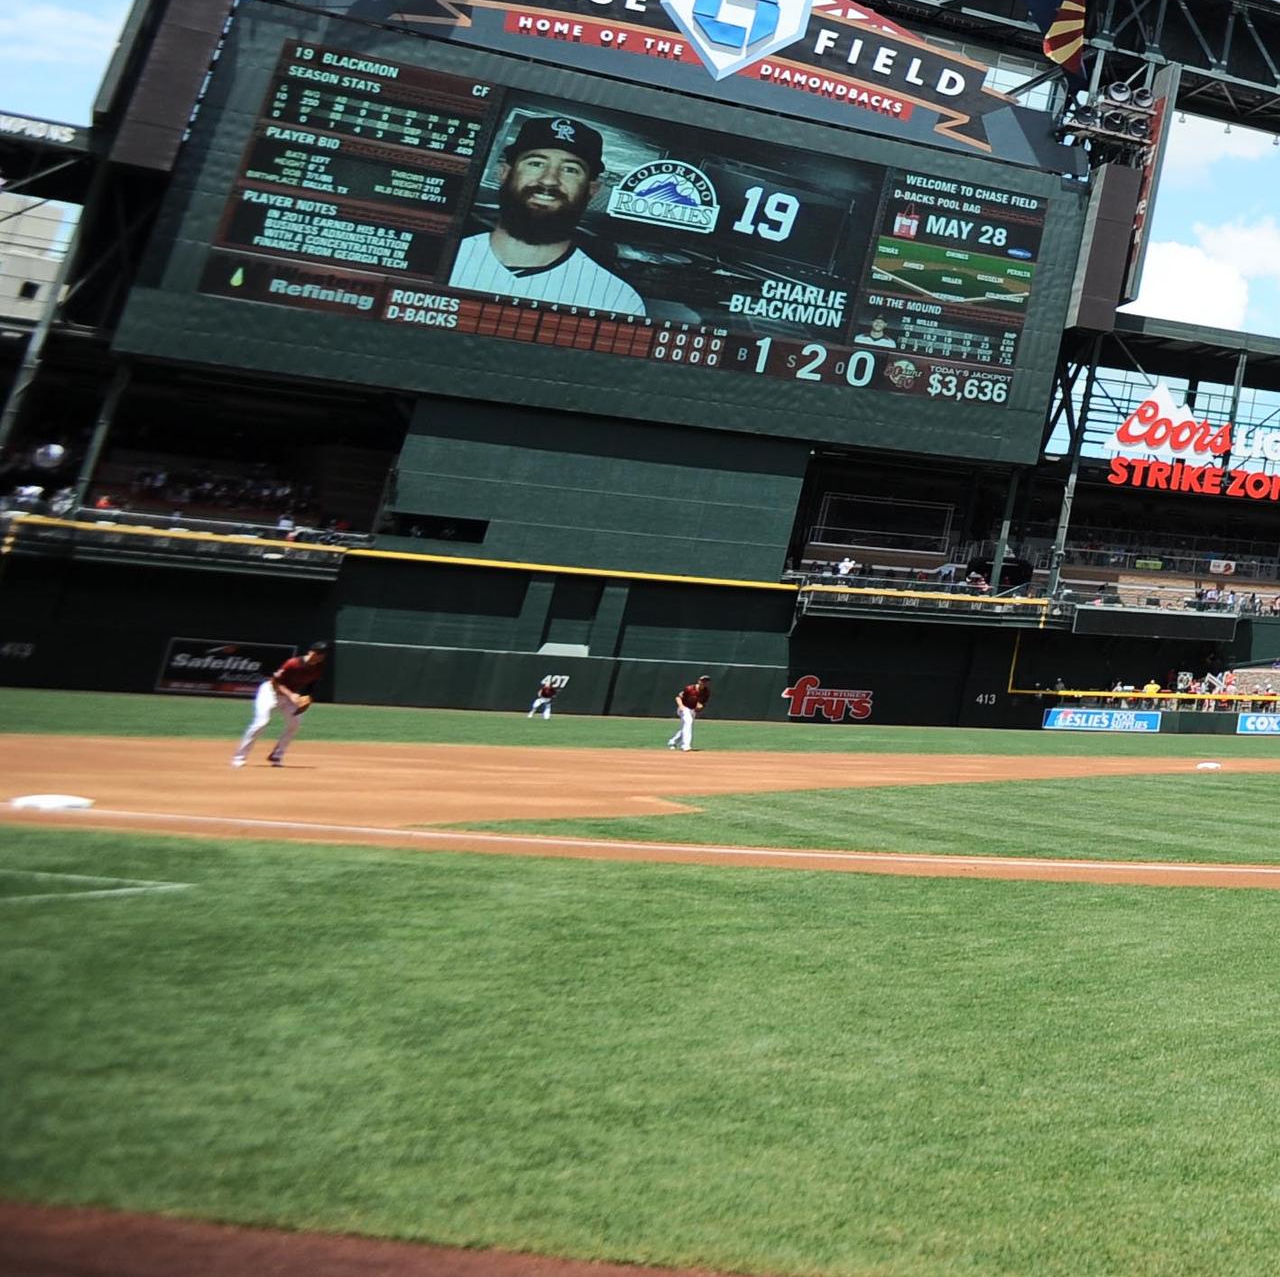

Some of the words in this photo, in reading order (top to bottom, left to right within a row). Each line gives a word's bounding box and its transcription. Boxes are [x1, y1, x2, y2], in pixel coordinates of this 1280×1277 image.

[296, 47, 314, 60] 19
[323, 53, 398, 78] BLACKMON
[472, 85, 490, 97] CF
[518, 16, 583, 36] HOME
[600, 30, 628, 44] OF
[644, 38, 684, 56] THE
[760, 64, 903, 113] DIAMONDBACKS
[814, 28, 966, 96] FIELD
[288, 66, 338, 85] SEASON
[342, 78, 380, 94] STATS
[266, 126, 315, 145] PLAYER
[318, 137, 340, 149] BIO
[426, 176, 445, 186] LEFT
[626, 163, 712, 202] COLORADO
[906, 175, 957, 194] WELCOME
[961, 187, 973, 197] TO
[975, 189, 1009, 204] CHASE
[1010, 196, 1038, 210] FIELD
[243, 190, 293, 208] PLAYER
[296, 200, 338, 215] NOTES
[615, 191, 713, 226] ROCKIES
[733, 186, 800, 242] 19
[894, 190, 934, 205] D-BACKS
[938, 197, 960, 210] POOL
[962, 204, 982, 214] BAG
[264, 219, 318, 236] BUSINESS
[320, 228, 409, 250] ADMINISTRATION
[267, 209, 280, 219] IN
[281, 212, 309, 224] 2011
[313, 216, 354, 231] EARNED
[357, 225, 374, 235] HIS
[401, 232, 412, 242] IN
[925, 215, 974, 240] MAY
[978, 225, 1007, 247] 28
[254, 236, 299, 252] FINANCE
[301, 244, 332, 257] FROM
[334, 249, 378, 265] GEORGIA
[379, 257, 408, 270] TECH
[264, 229, 292, 242] WITH
[295, 234, 302, 242] A
[305, 235, 390, 256] CONCENTRATION
[393, 249, 405, 259] IN
[269, 278, 375, 309] Refining
[391, 290, 461, 312] ROCKIES
[762, 280, 847, 310] CHARLIE
[869, 295, 883, 306] ON
[887, 298, 903, 309] THE
[907, 302, 942, 315] MOUND
[386, 305, 458, 328] D-BACKS
[729, 294, 843, 328] BLACKMON
[655, 347, 666, 359] 0
[672, 349, 682, 361] 0
[689, 351, 700, 363] 0
[707, 354, 717, 366] 0
[659, 332, 670, 344] 0
[676, 334, 686, 346] 0
[694, 336, 704, 348] 0
[710, 339, 721, 351] 0
[738, 348, 748, 361] B
[756, 337, 773, 373] 1
[787, 355, 797, 368] S
[796, 344, 827, 381] 2
[846, 350, 875, 387] 0
[930, 365, 968, 377] TODAY'S
[970, 371, 1012, 383] JACKPOT
[927, 372, 1008, 403] $3,636
[1117, 400, 1232, 455] Coors
[1107, 456, 1223, 494] STRIKE
[171, 652, 261, 671] Safelite
[781, 675, 873, 722] fry's
[976, 694, 996, 705] 413
[1055, 711, 1109, 727] LESLIE'S
[1114, 713, 1136, 721] POOL
[1111, 721, 1148, 729] SUPPLIES
[1245, 717, 1280, 731] COX
